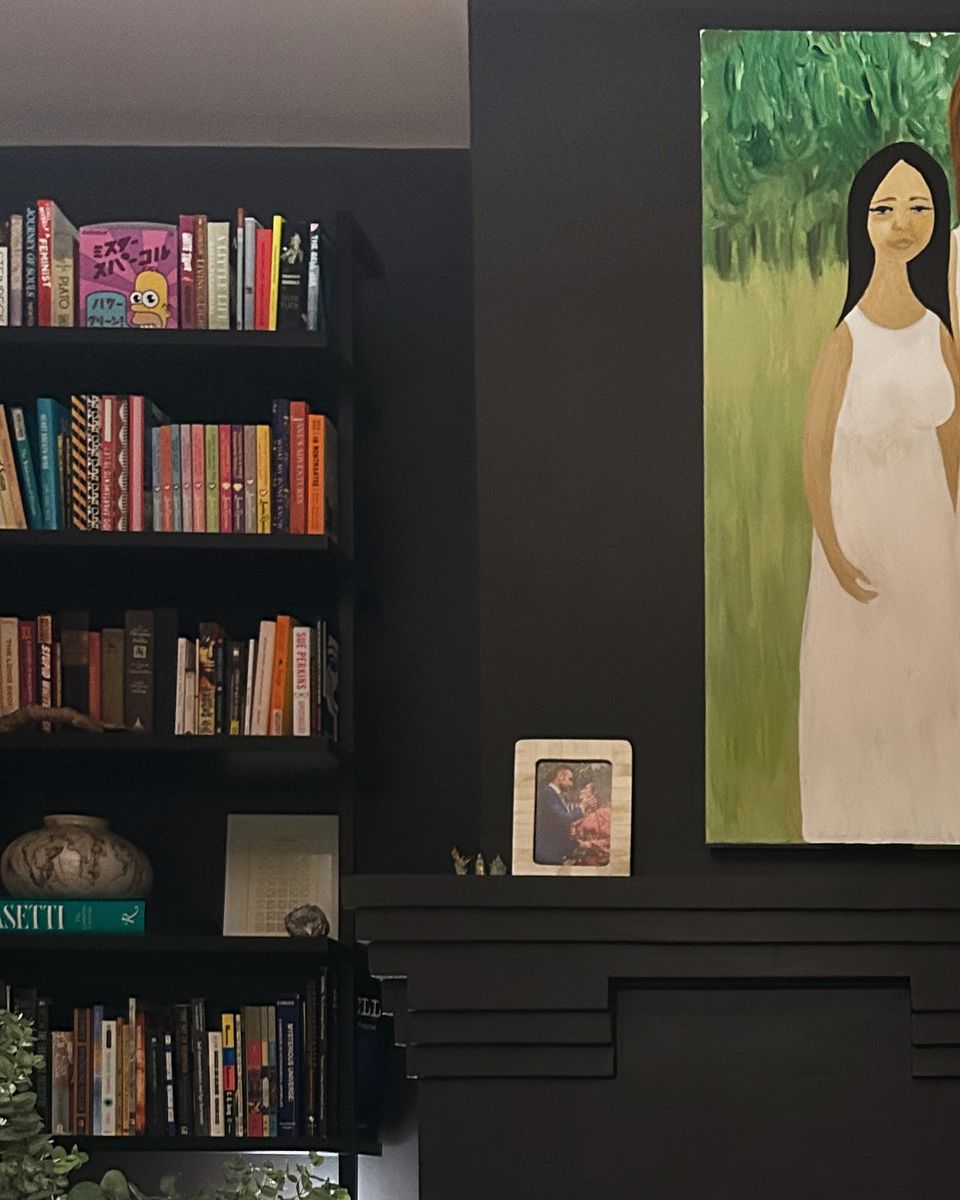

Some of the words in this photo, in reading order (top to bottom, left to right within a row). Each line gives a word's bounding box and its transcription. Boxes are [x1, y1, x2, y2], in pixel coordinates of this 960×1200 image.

[26, 208, 36, 250] JOURNEY
[26, 252, 35, 265] OF
[38, 238, 51, 289] FEMINIST
[92, 236, 139, 258] ミスター
[26, 267, 35, 298] SOULS
[58, 276, 71, 310] PLATO
[295, 631, 307, 649] SUE
[41, 644, 51, 679] STUPID
[296, 651, 307, 690] PERKINS
